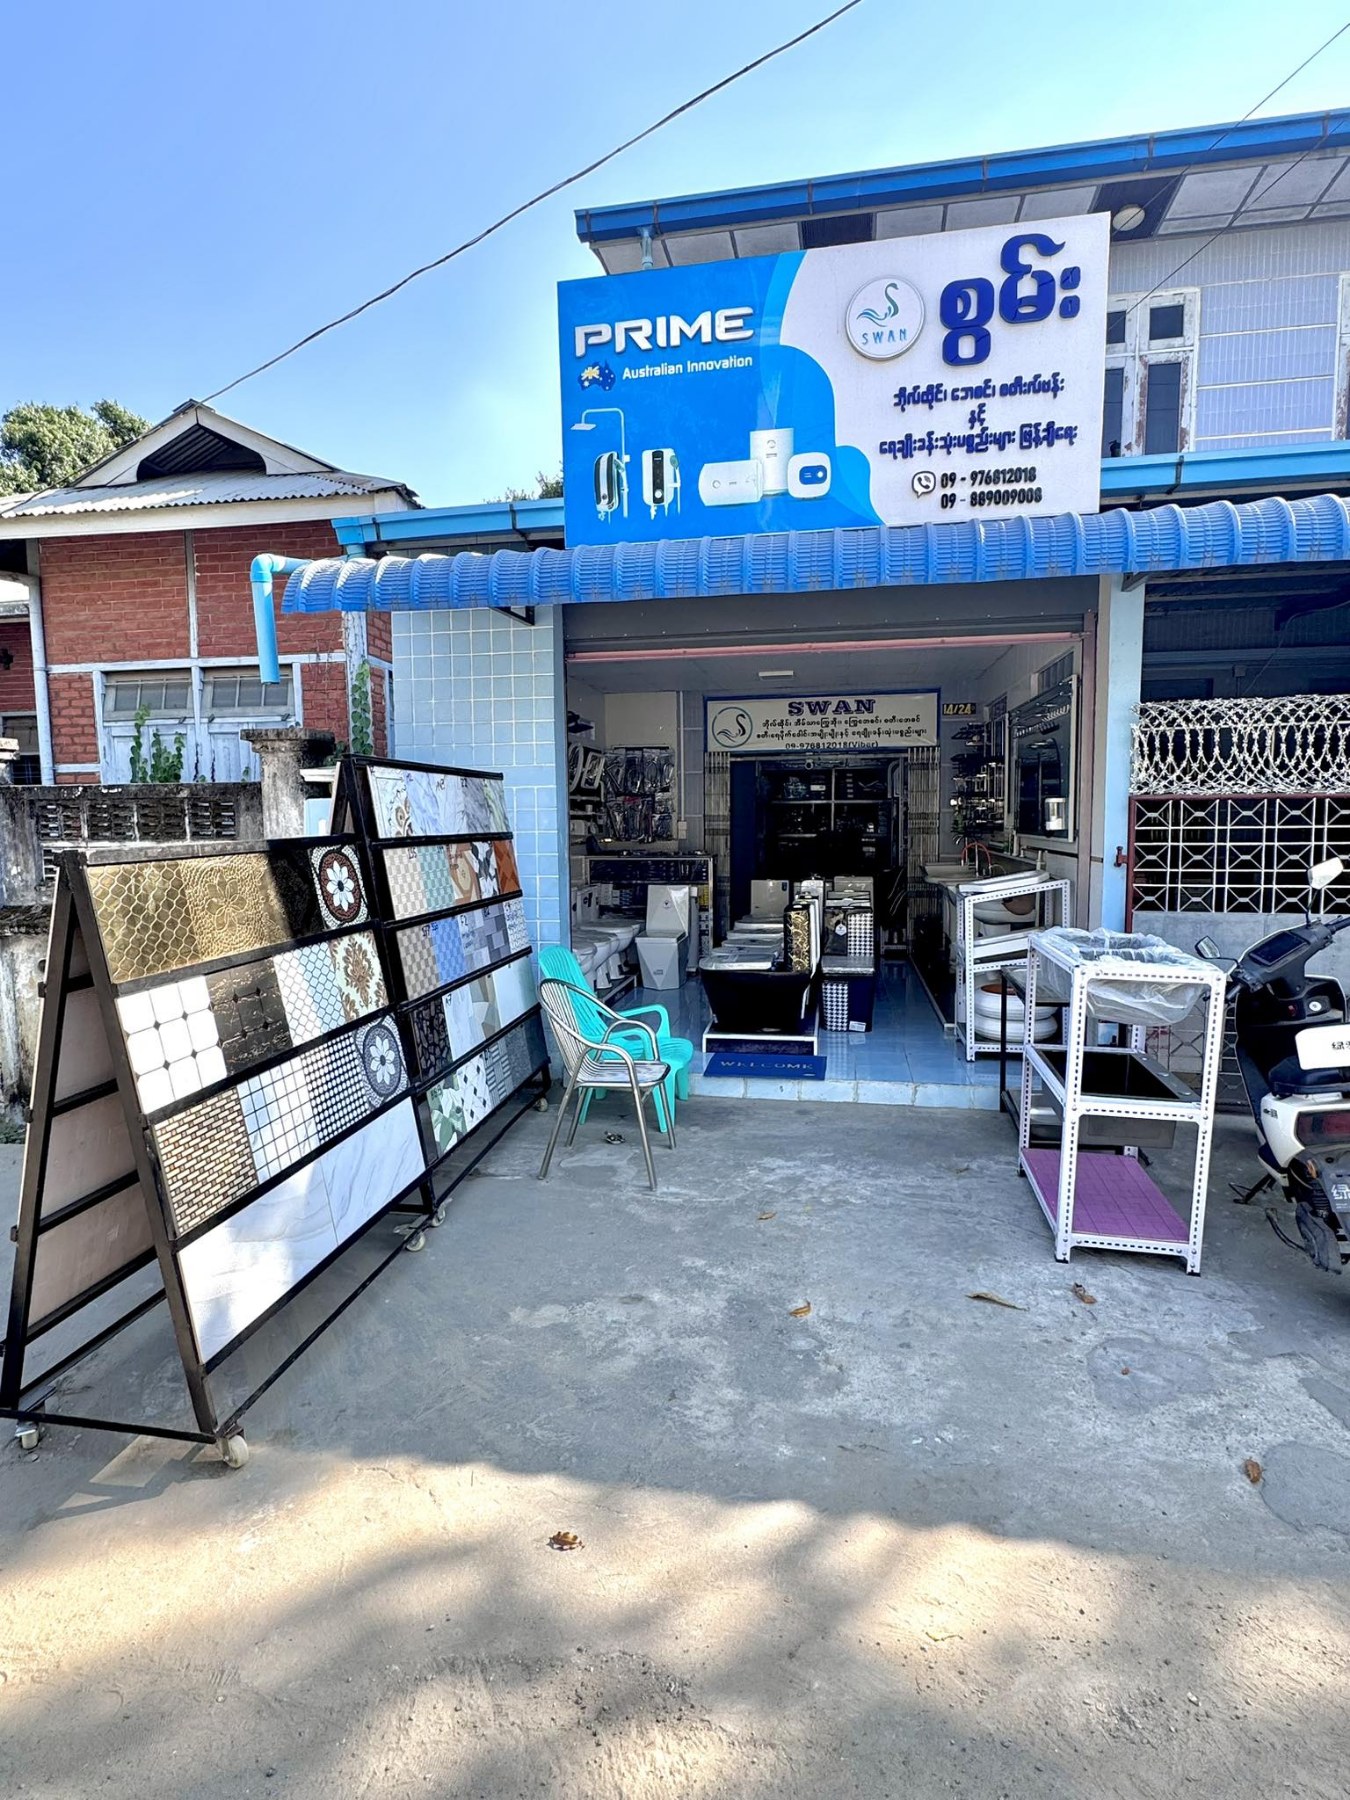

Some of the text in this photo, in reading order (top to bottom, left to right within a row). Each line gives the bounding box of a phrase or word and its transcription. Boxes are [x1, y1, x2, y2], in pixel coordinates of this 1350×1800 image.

[940, 233, 1081, 366] စွမ်း
[574, 306, 755, 358] PRIME
[862, 328, 907, 345] SWAN
[622, 355, 753, 380] Australian Innovation
[940, 472, 957, 488] 09
[970, 466, 1037, 487] 976812018
[940, 493, 957, 509] 09
[970, 487, 1043, 507] 889009008
[788, 699, 876, 716] SWAN
[720, 1060, 814, 1070] WELCOME
